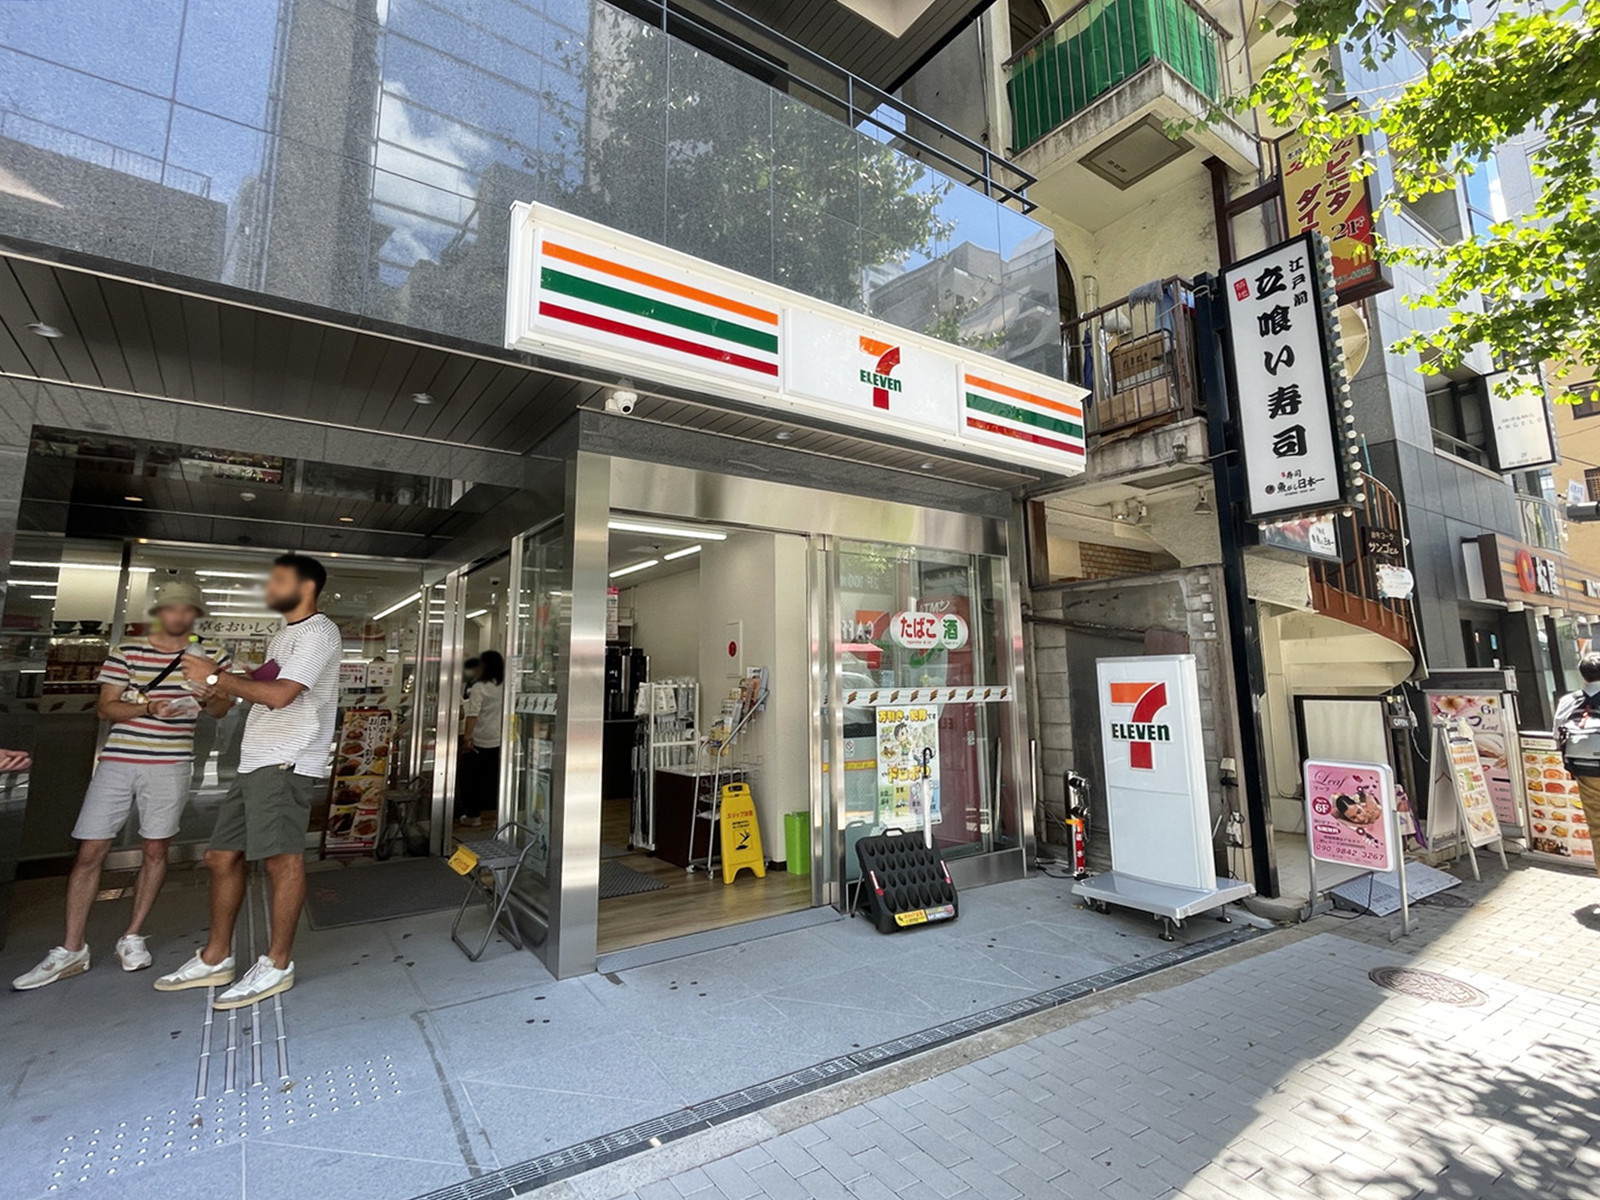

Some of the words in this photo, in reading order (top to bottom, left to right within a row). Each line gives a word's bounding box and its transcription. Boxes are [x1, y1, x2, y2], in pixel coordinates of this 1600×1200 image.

[1331, 216, 1365, 242] 2F
[1255, 265, 1308, 459] 立喰い寿司
[901, 617, 937, 638] たばこ
[943, 619, 958, 640] 酒
[1313, 770, 1350, 790] Leaf
